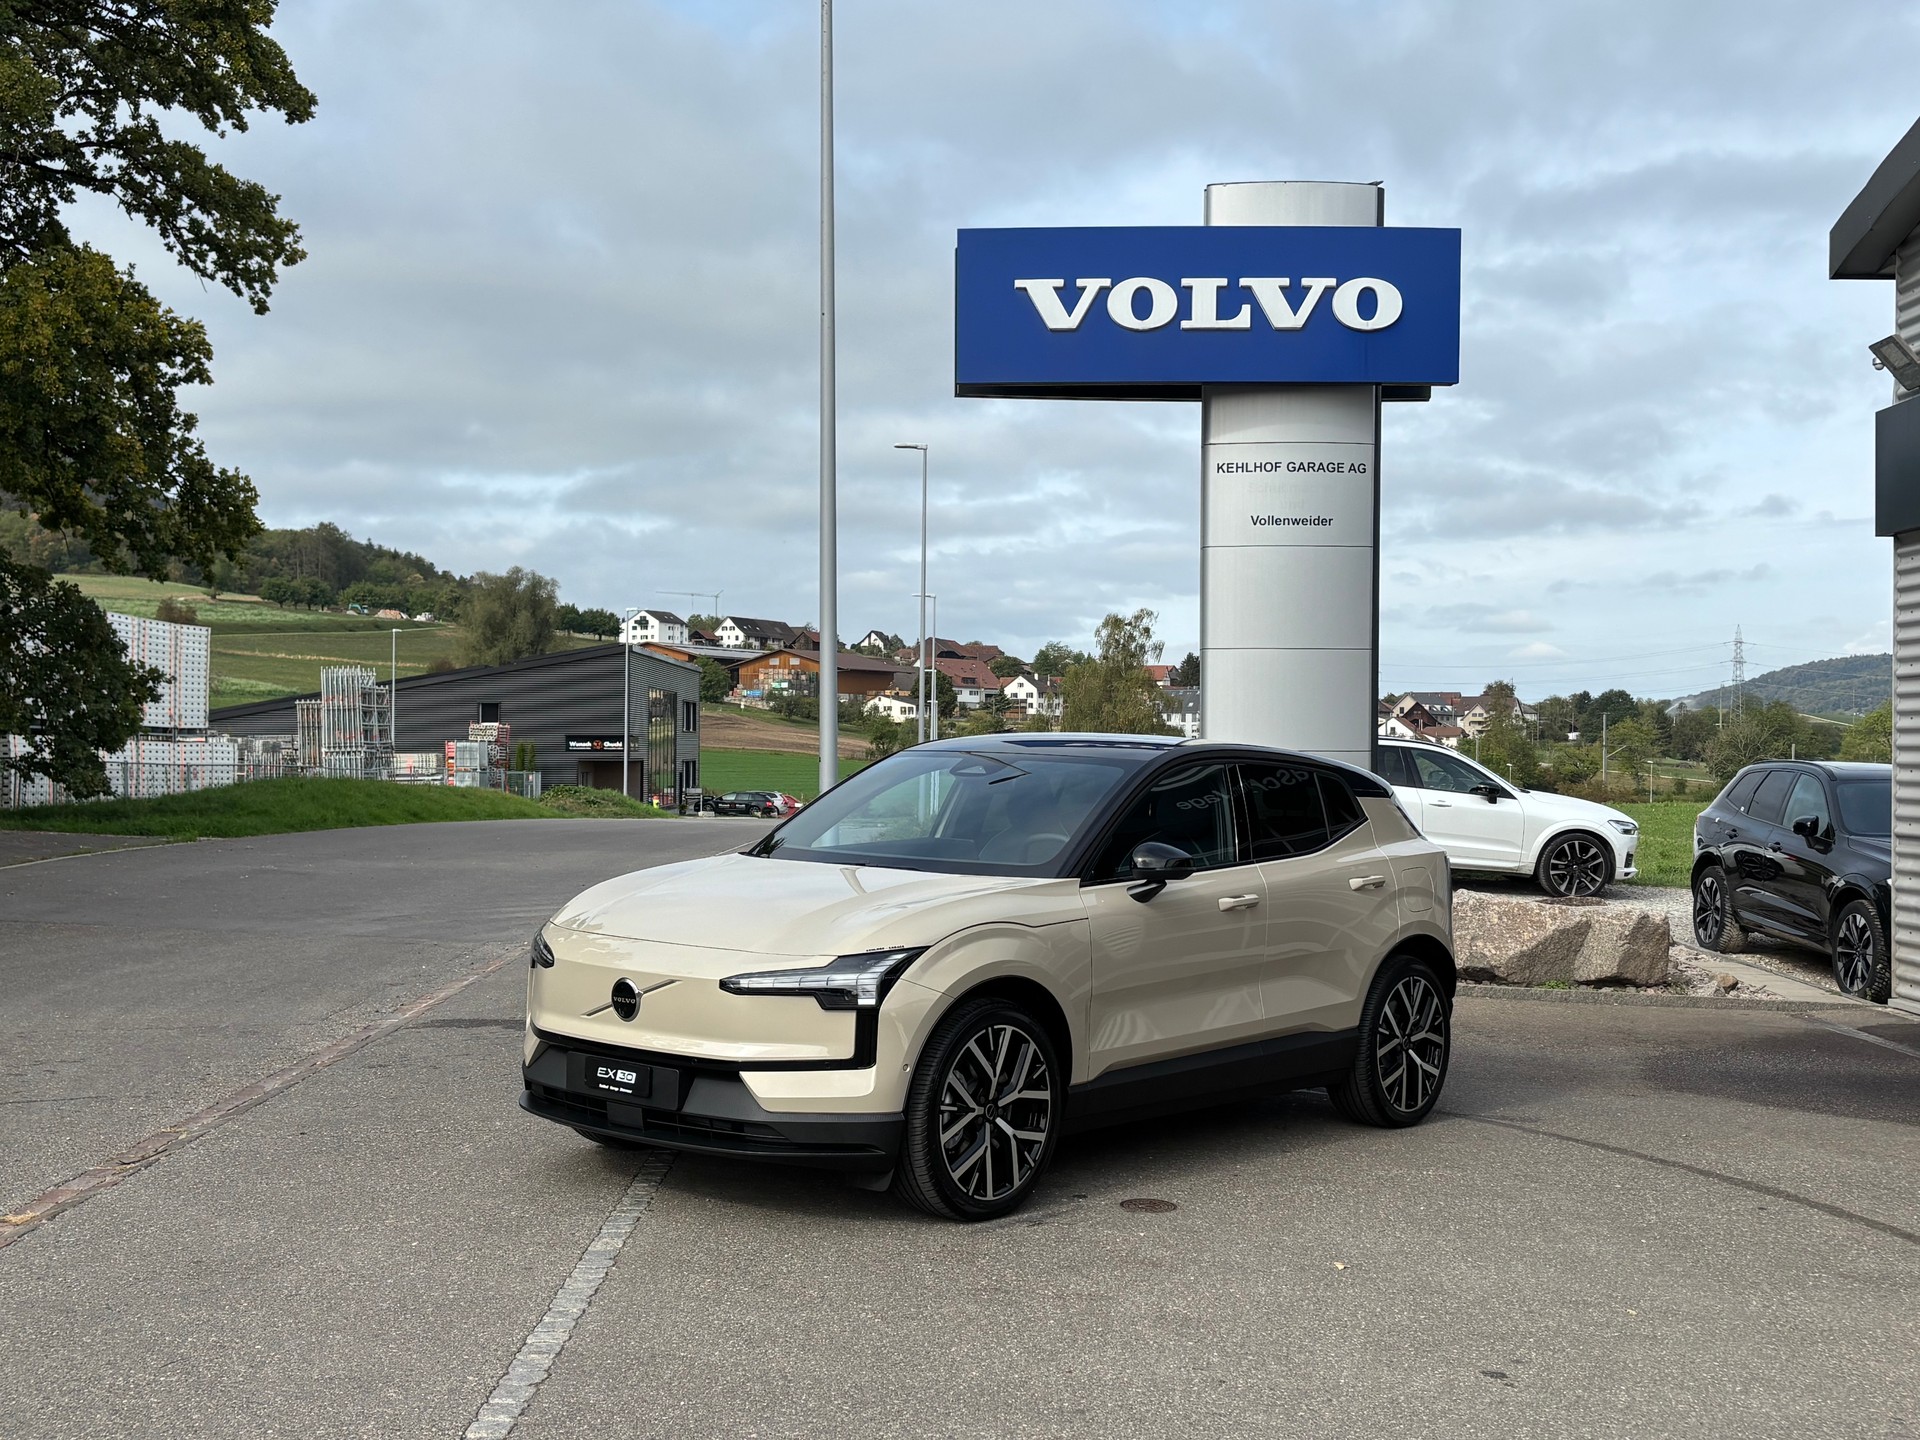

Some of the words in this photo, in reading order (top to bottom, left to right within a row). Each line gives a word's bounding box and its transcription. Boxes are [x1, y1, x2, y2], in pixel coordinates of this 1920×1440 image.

[1014, 277, 1403, 331] VOLVO
[1216, 461, 1282, 474] KEHLHOF
[1286, 461, 1345, 474] GARAGE
[1347, 462, 1367, 474] AG
[1250, 515, 1334, 527] Vollenweider
[613, 996, 636, 1004] VOLVO
[596, 1066, 637, 1084] EX30
